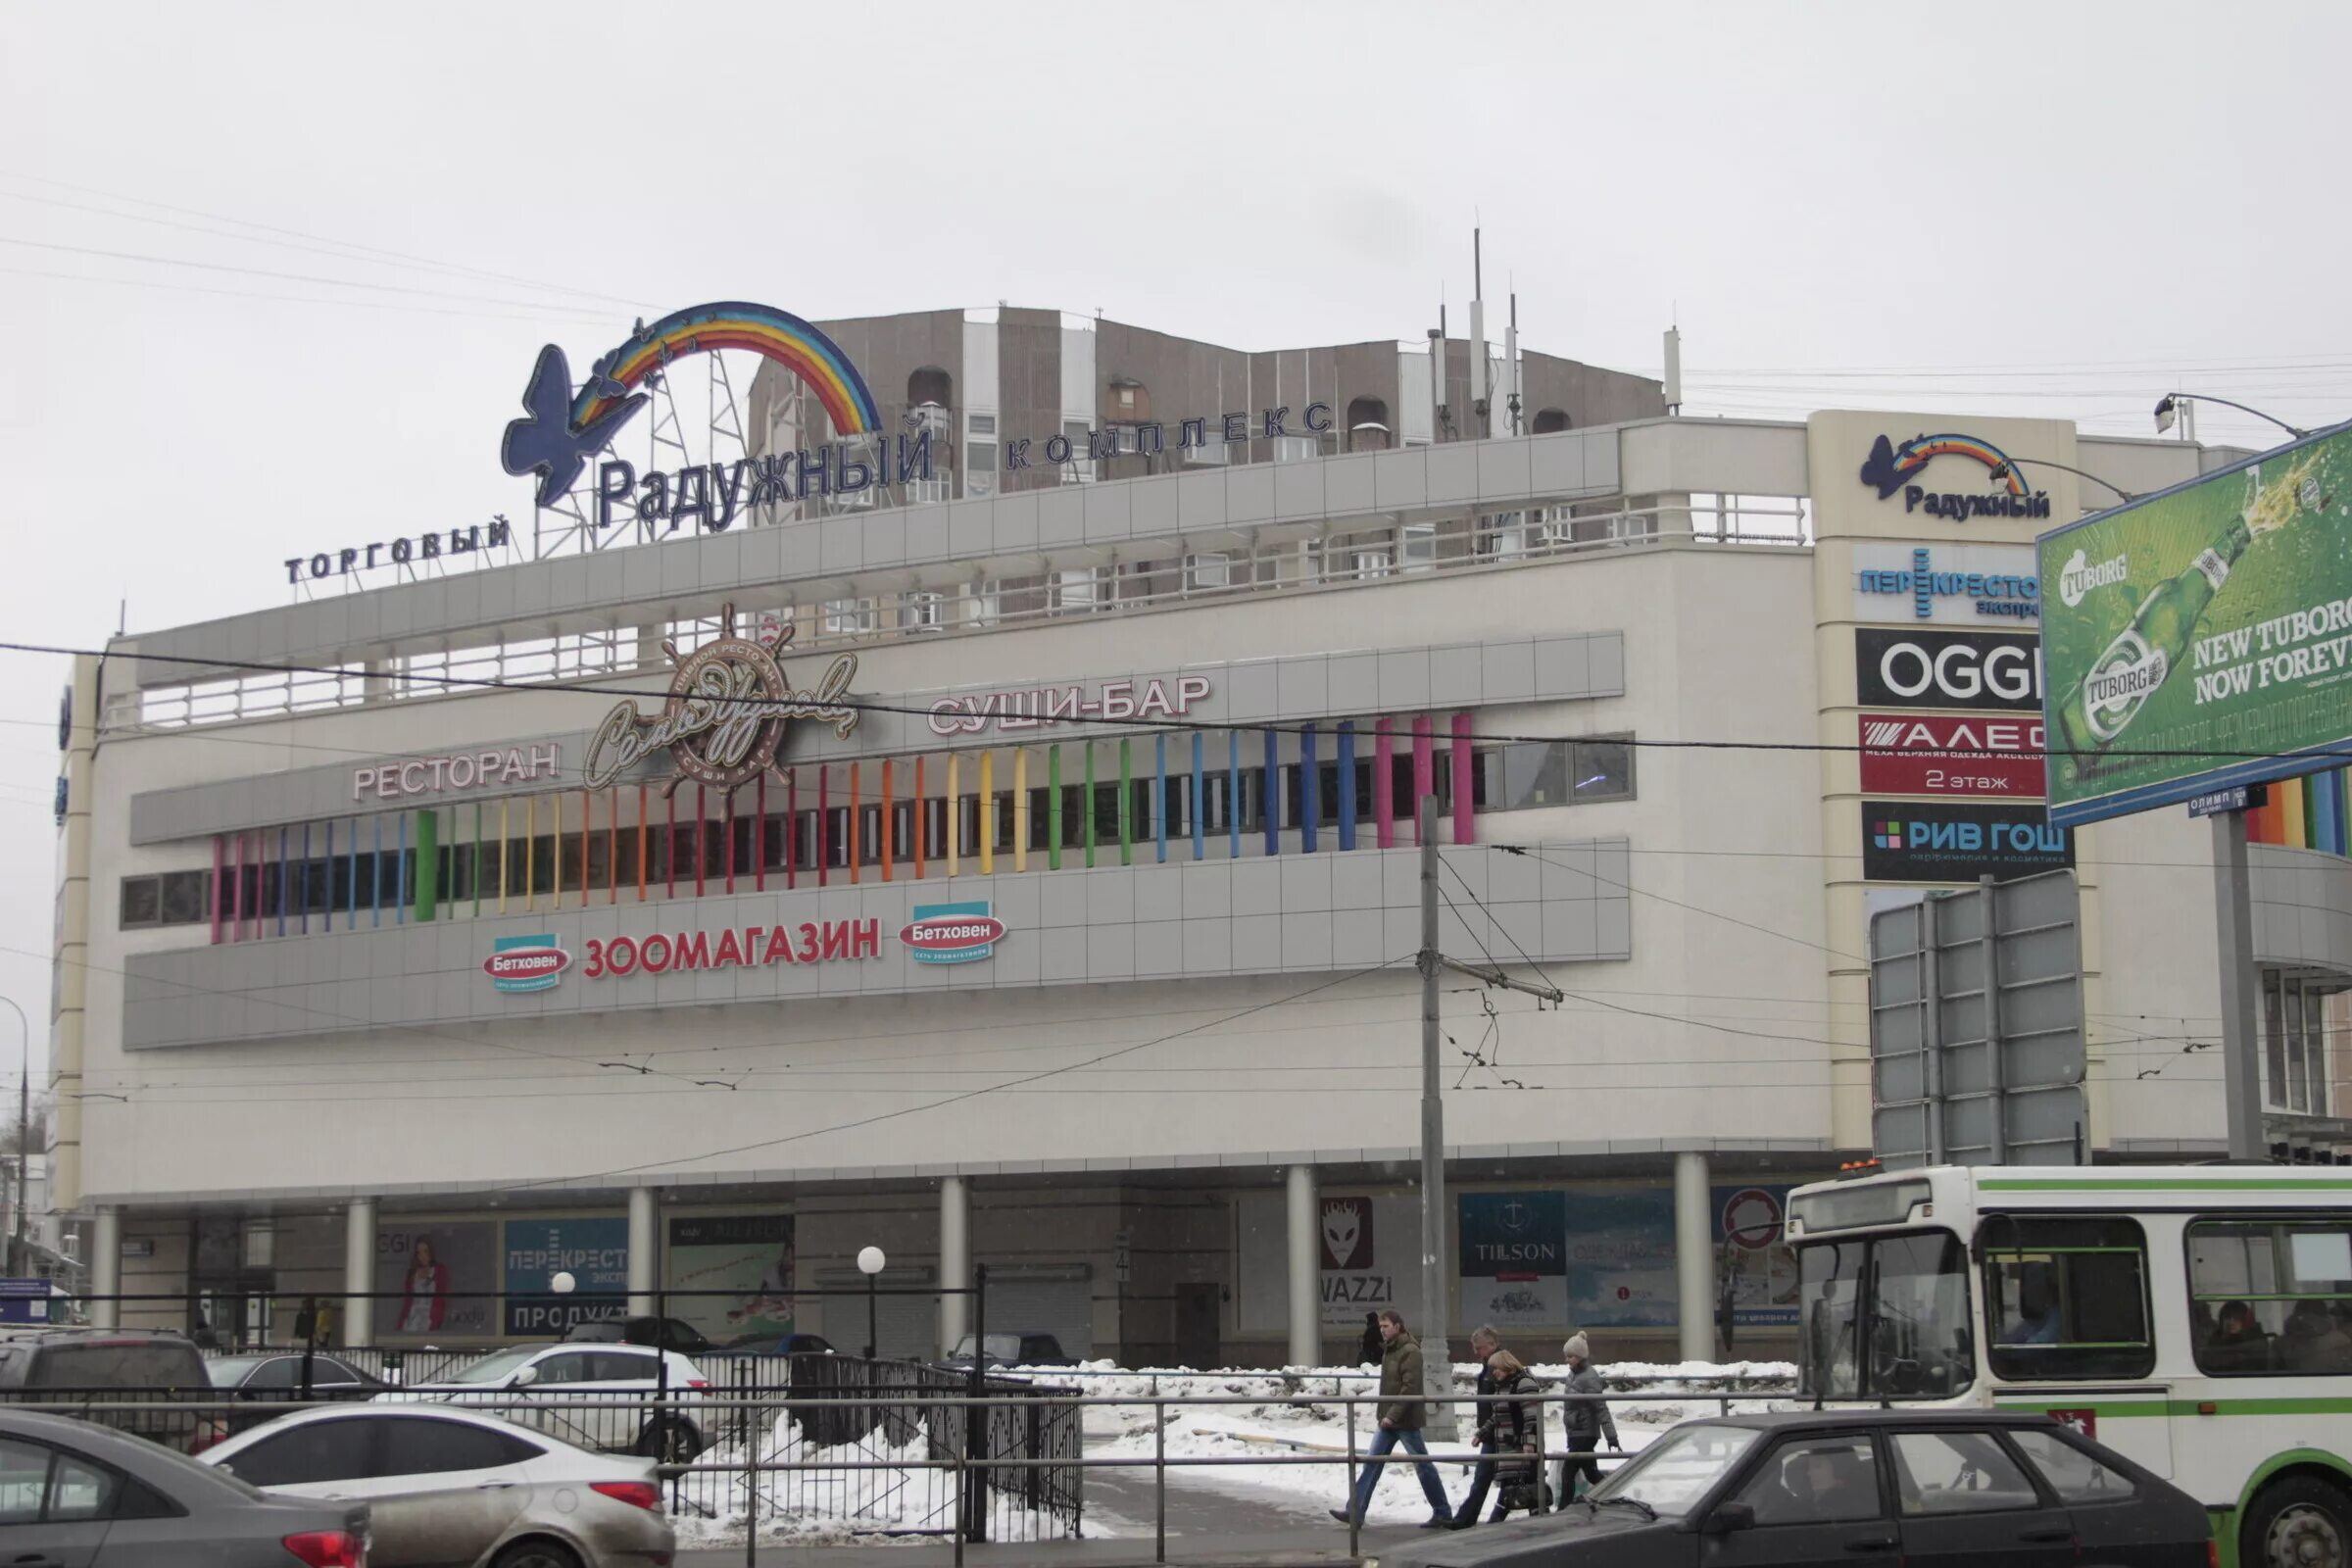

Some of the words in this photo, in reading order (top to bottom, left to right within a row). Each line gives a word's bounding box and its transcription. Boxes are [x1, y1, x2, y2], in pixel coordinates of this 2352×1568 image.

[1006, 402, 1332, 470] КОМПЛЕКС
[599, 412, 932, 532] Радужный
[1905, 485, 2050, 522] Радужный
[284, 514, 510, 583] ТОРГОВЫЙ
[2064, 554, 2128, 597] TUBORG
[721, 645, 776, 684] РЕСТОАН
[2193, 626, 2252, 669] NEW
[1880, 643, 2042, 700] OGGI
[2088, 667, 2147, 704] TUBORG
[2193, 662, 2254, 705] NOW
[2257, 634, 2352, 688] FOREV
[927, 676, 1211, 736] СУШИ-БАР
[353, 744, 562, 802] РЕСТОРАН
[683, 757, 725, 781] СУШИ
[737, 749, 764, 777] БАР
[1926, 770, 1945, 788] 2
[1950, 776, 2009, 789] этаж
[2190, 792, 2230, 809] ОЛИМП
[1909, 821, 1984, 851] РИВ
[1990, 823, 2065, 852] ГОШ
[583, 918, 882, 979] ЗООМАГАЗИН
[912, 924, 991, 941] Бетховен
[493, 955, 558, 972] Бетховен
